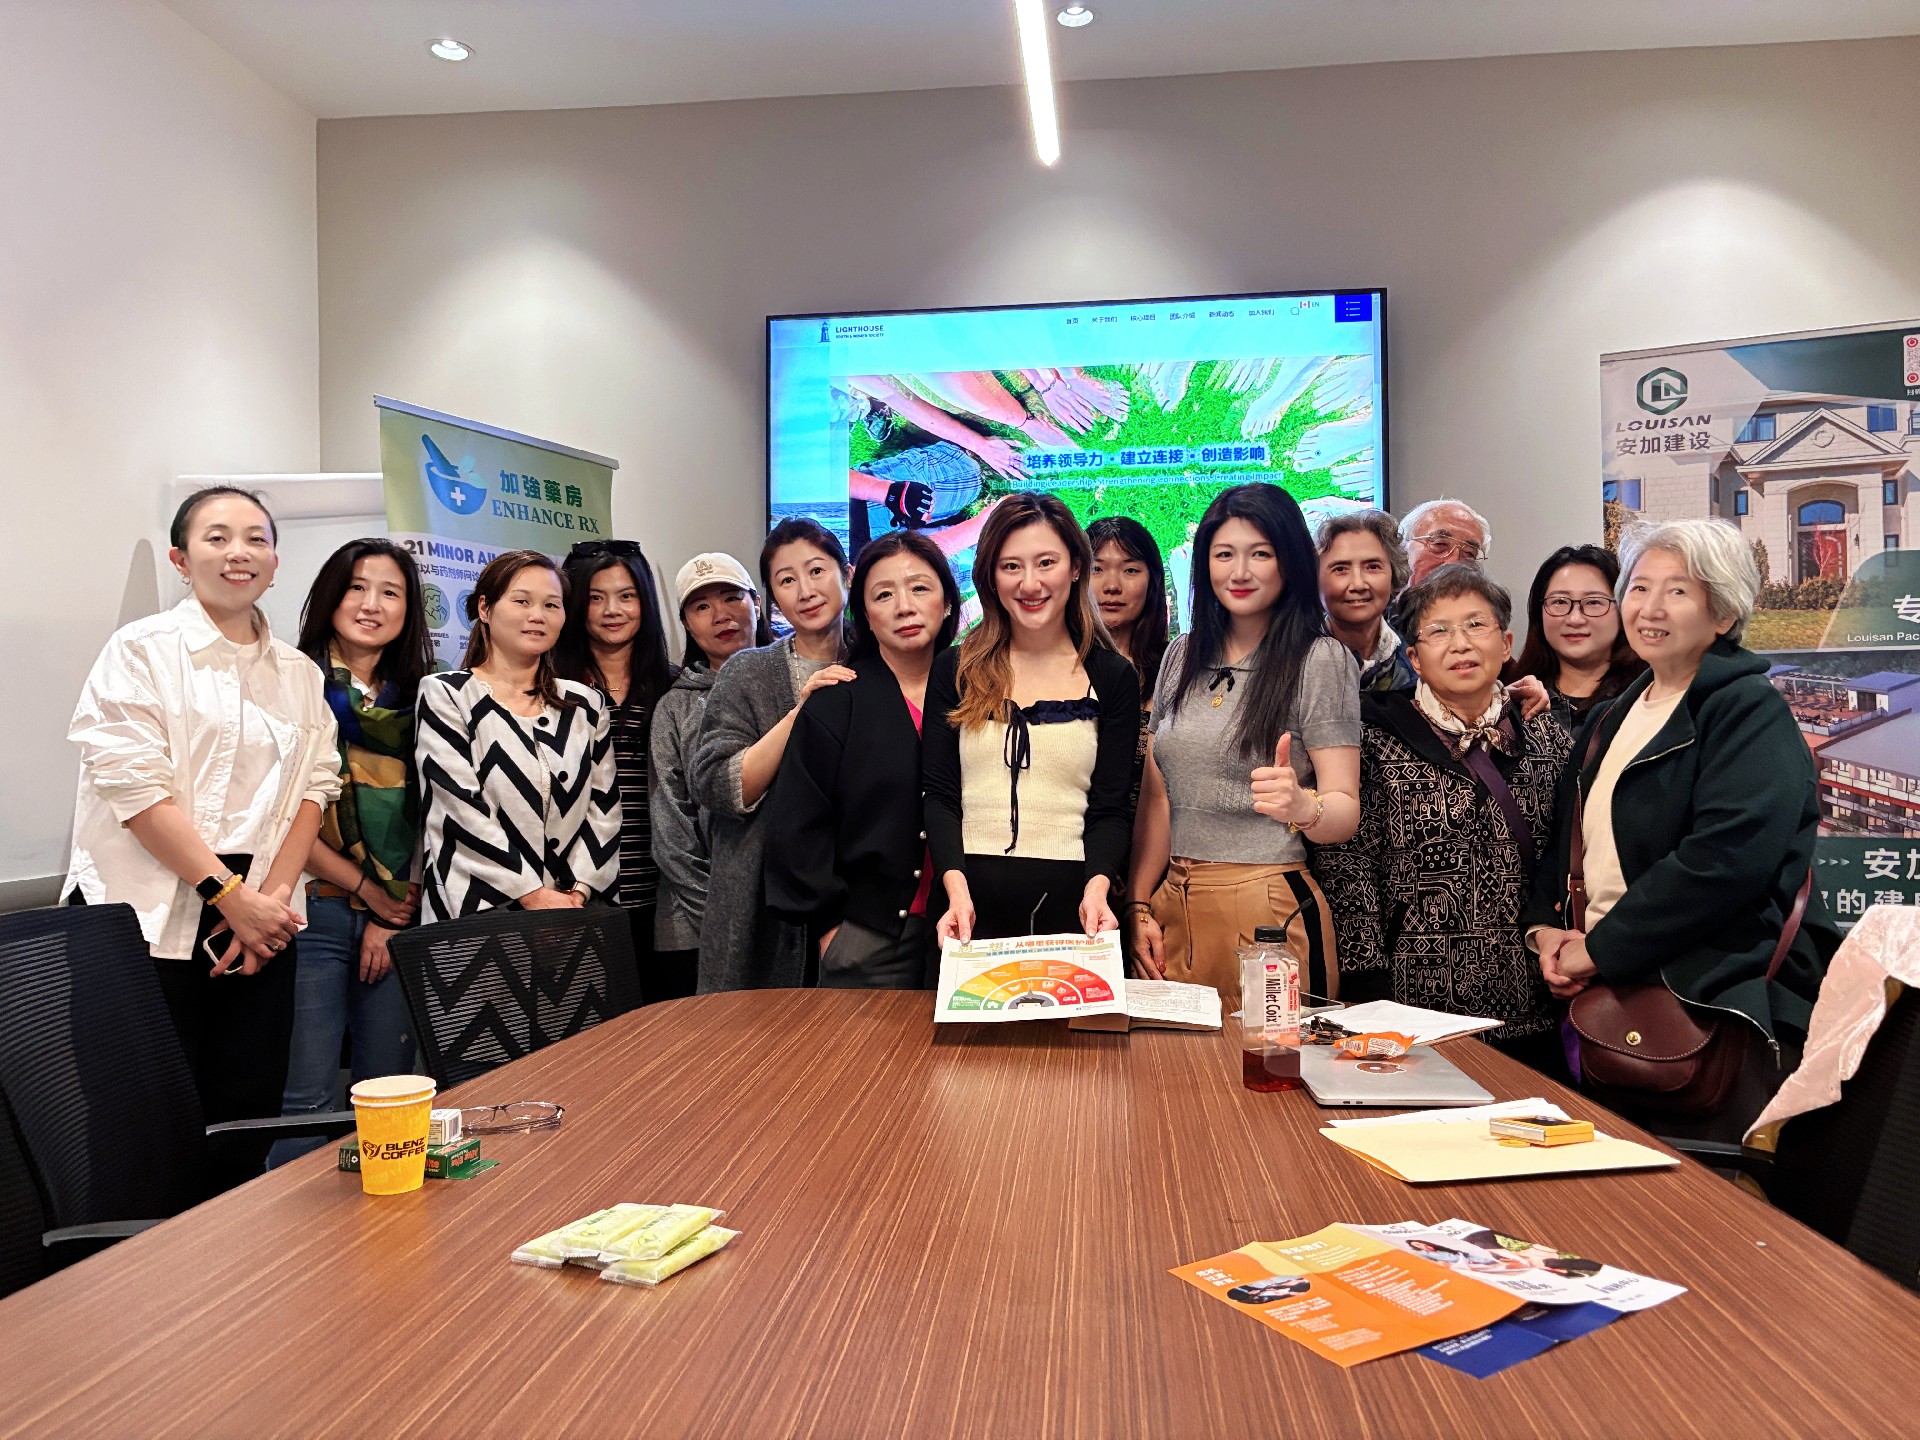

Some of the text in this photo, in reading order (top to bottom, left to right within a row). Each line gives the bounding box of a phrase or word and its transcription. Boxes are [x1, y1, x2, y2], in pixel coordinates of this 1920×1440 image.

[835, 324, 884, 333] LIGHTHOUSE
[1091, 316, 1118, 324] 关于我们
[1615, 414, 1712, 433] LOUISAN
[1616, 431, 1711, 457] 安加建设
[499, 469, 583, 508] 加強藥房
[1012, 480, 1046, 489] Building
[1252, 472, 1282, 481] Impact
[492, 499, 600, 534] ENHANCE RX
[403, 540, 424, 555] 21
[427, 541, 475, 563] MINOR
[415, 563, 481, 582] 以与药剂师问诊
[1847, 631, 1920, 642] Louisan Pac
[1265, 978, 1282, 1003] Millet
[1265, 1004, 1282, 1023] Coix
[381, 1144, 426, 1160] COFFEE
[385, 1136, 425, 1151] BLENZ
